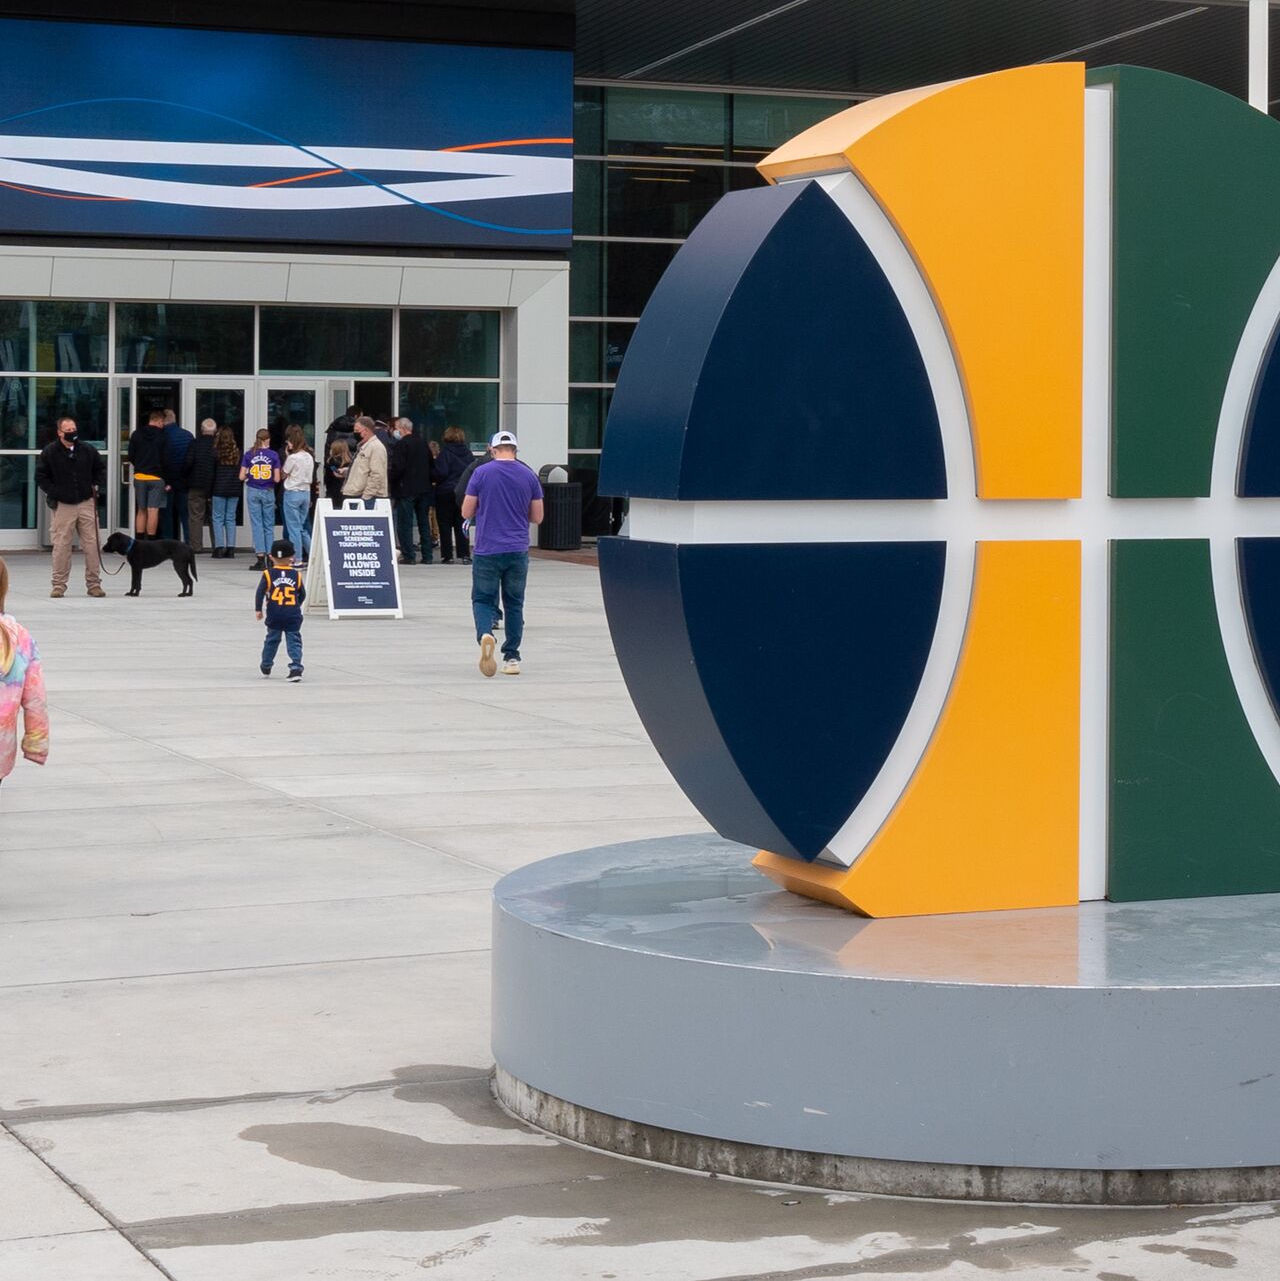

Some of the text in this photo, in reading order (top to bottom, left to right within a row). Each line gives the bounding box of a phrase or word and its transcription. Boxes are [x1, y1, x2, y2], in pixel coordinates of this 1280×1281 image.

[250, 464, 272, 480] 45
[343, 552, 378, 560] NO BAGS
[342, 560, 381, 569] ALLOWED
[349, 569, 376, 577] INSIDE
[271, 586, 296, 606] 45
